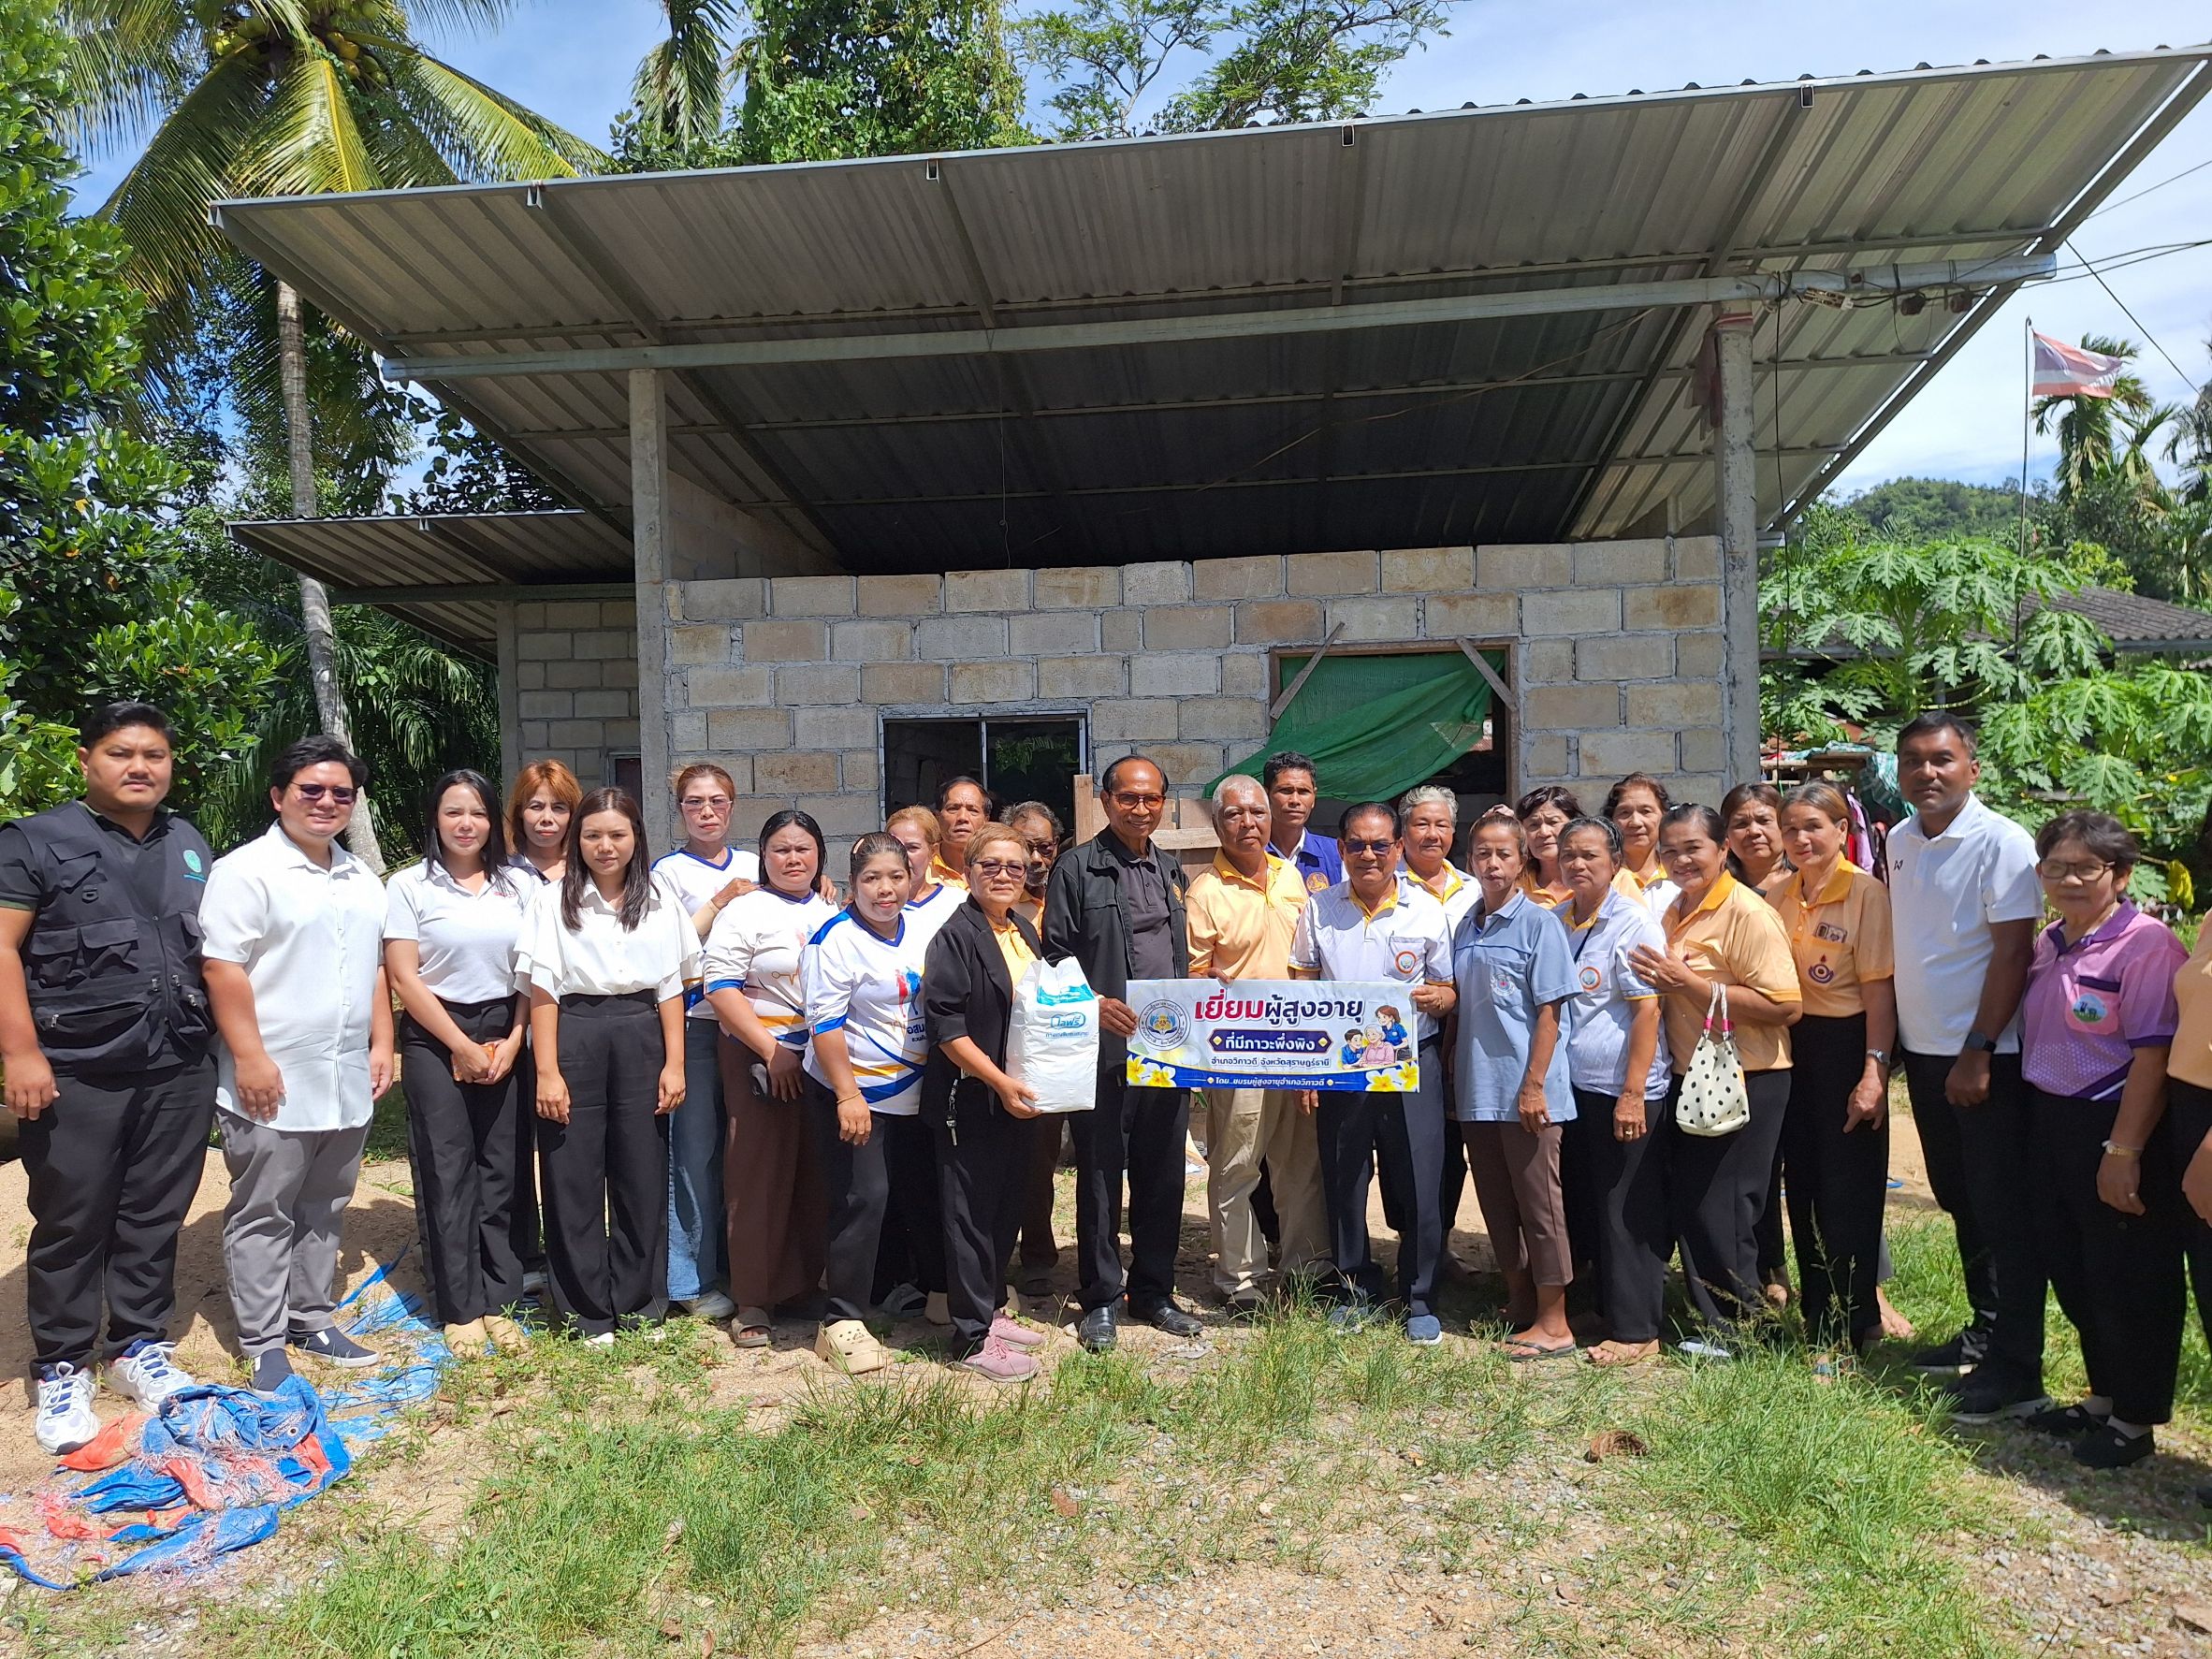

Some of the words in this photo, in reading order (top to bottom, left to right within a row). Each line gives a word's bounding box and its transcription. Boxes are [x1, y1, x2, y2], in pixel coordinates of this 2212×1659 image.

[1195, 989, 1363, 1026] เยี่ยมผู้สูงอายุ
[1225, 1032, 1316, 1051] ที่มีภาวะพึ่งพิง
